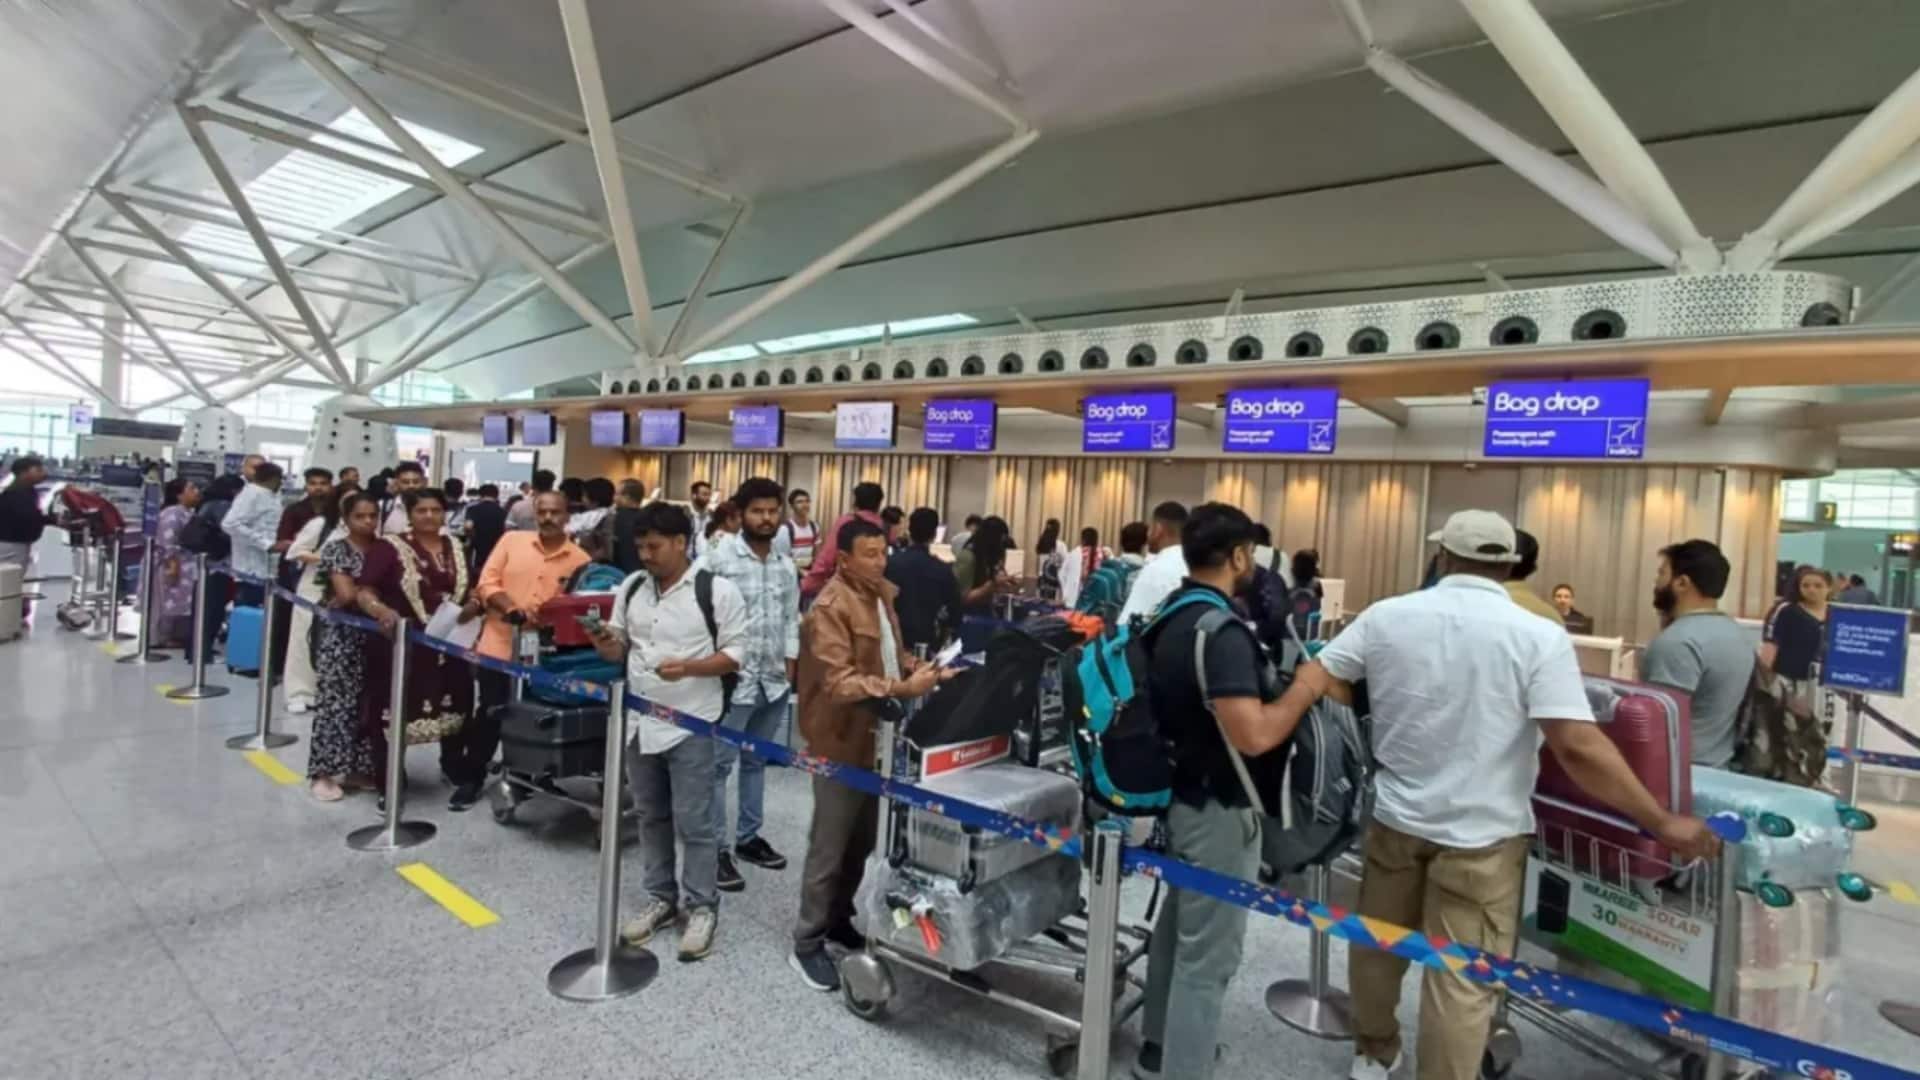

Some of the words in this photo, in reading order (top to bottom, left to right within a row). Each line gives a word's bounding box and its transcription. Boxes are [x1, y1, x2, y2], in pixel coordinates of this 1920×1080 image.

[1088, 403, 1114, 422] Bag
[1116, 402, 1147, 420] drop
[1230, 398, 1262, 418] Bag
[1265, 397, 1304, 418] drop
[1495, 392, 1539, 416] Bag
[1544, 391, 1600, 416] drop
[928, 408, 948, 424] Bag
[949, 408, 973, 422] drop
[1592, 903, 1617, 926] 30
[1647, 907, 1701, 937] SOLAR
